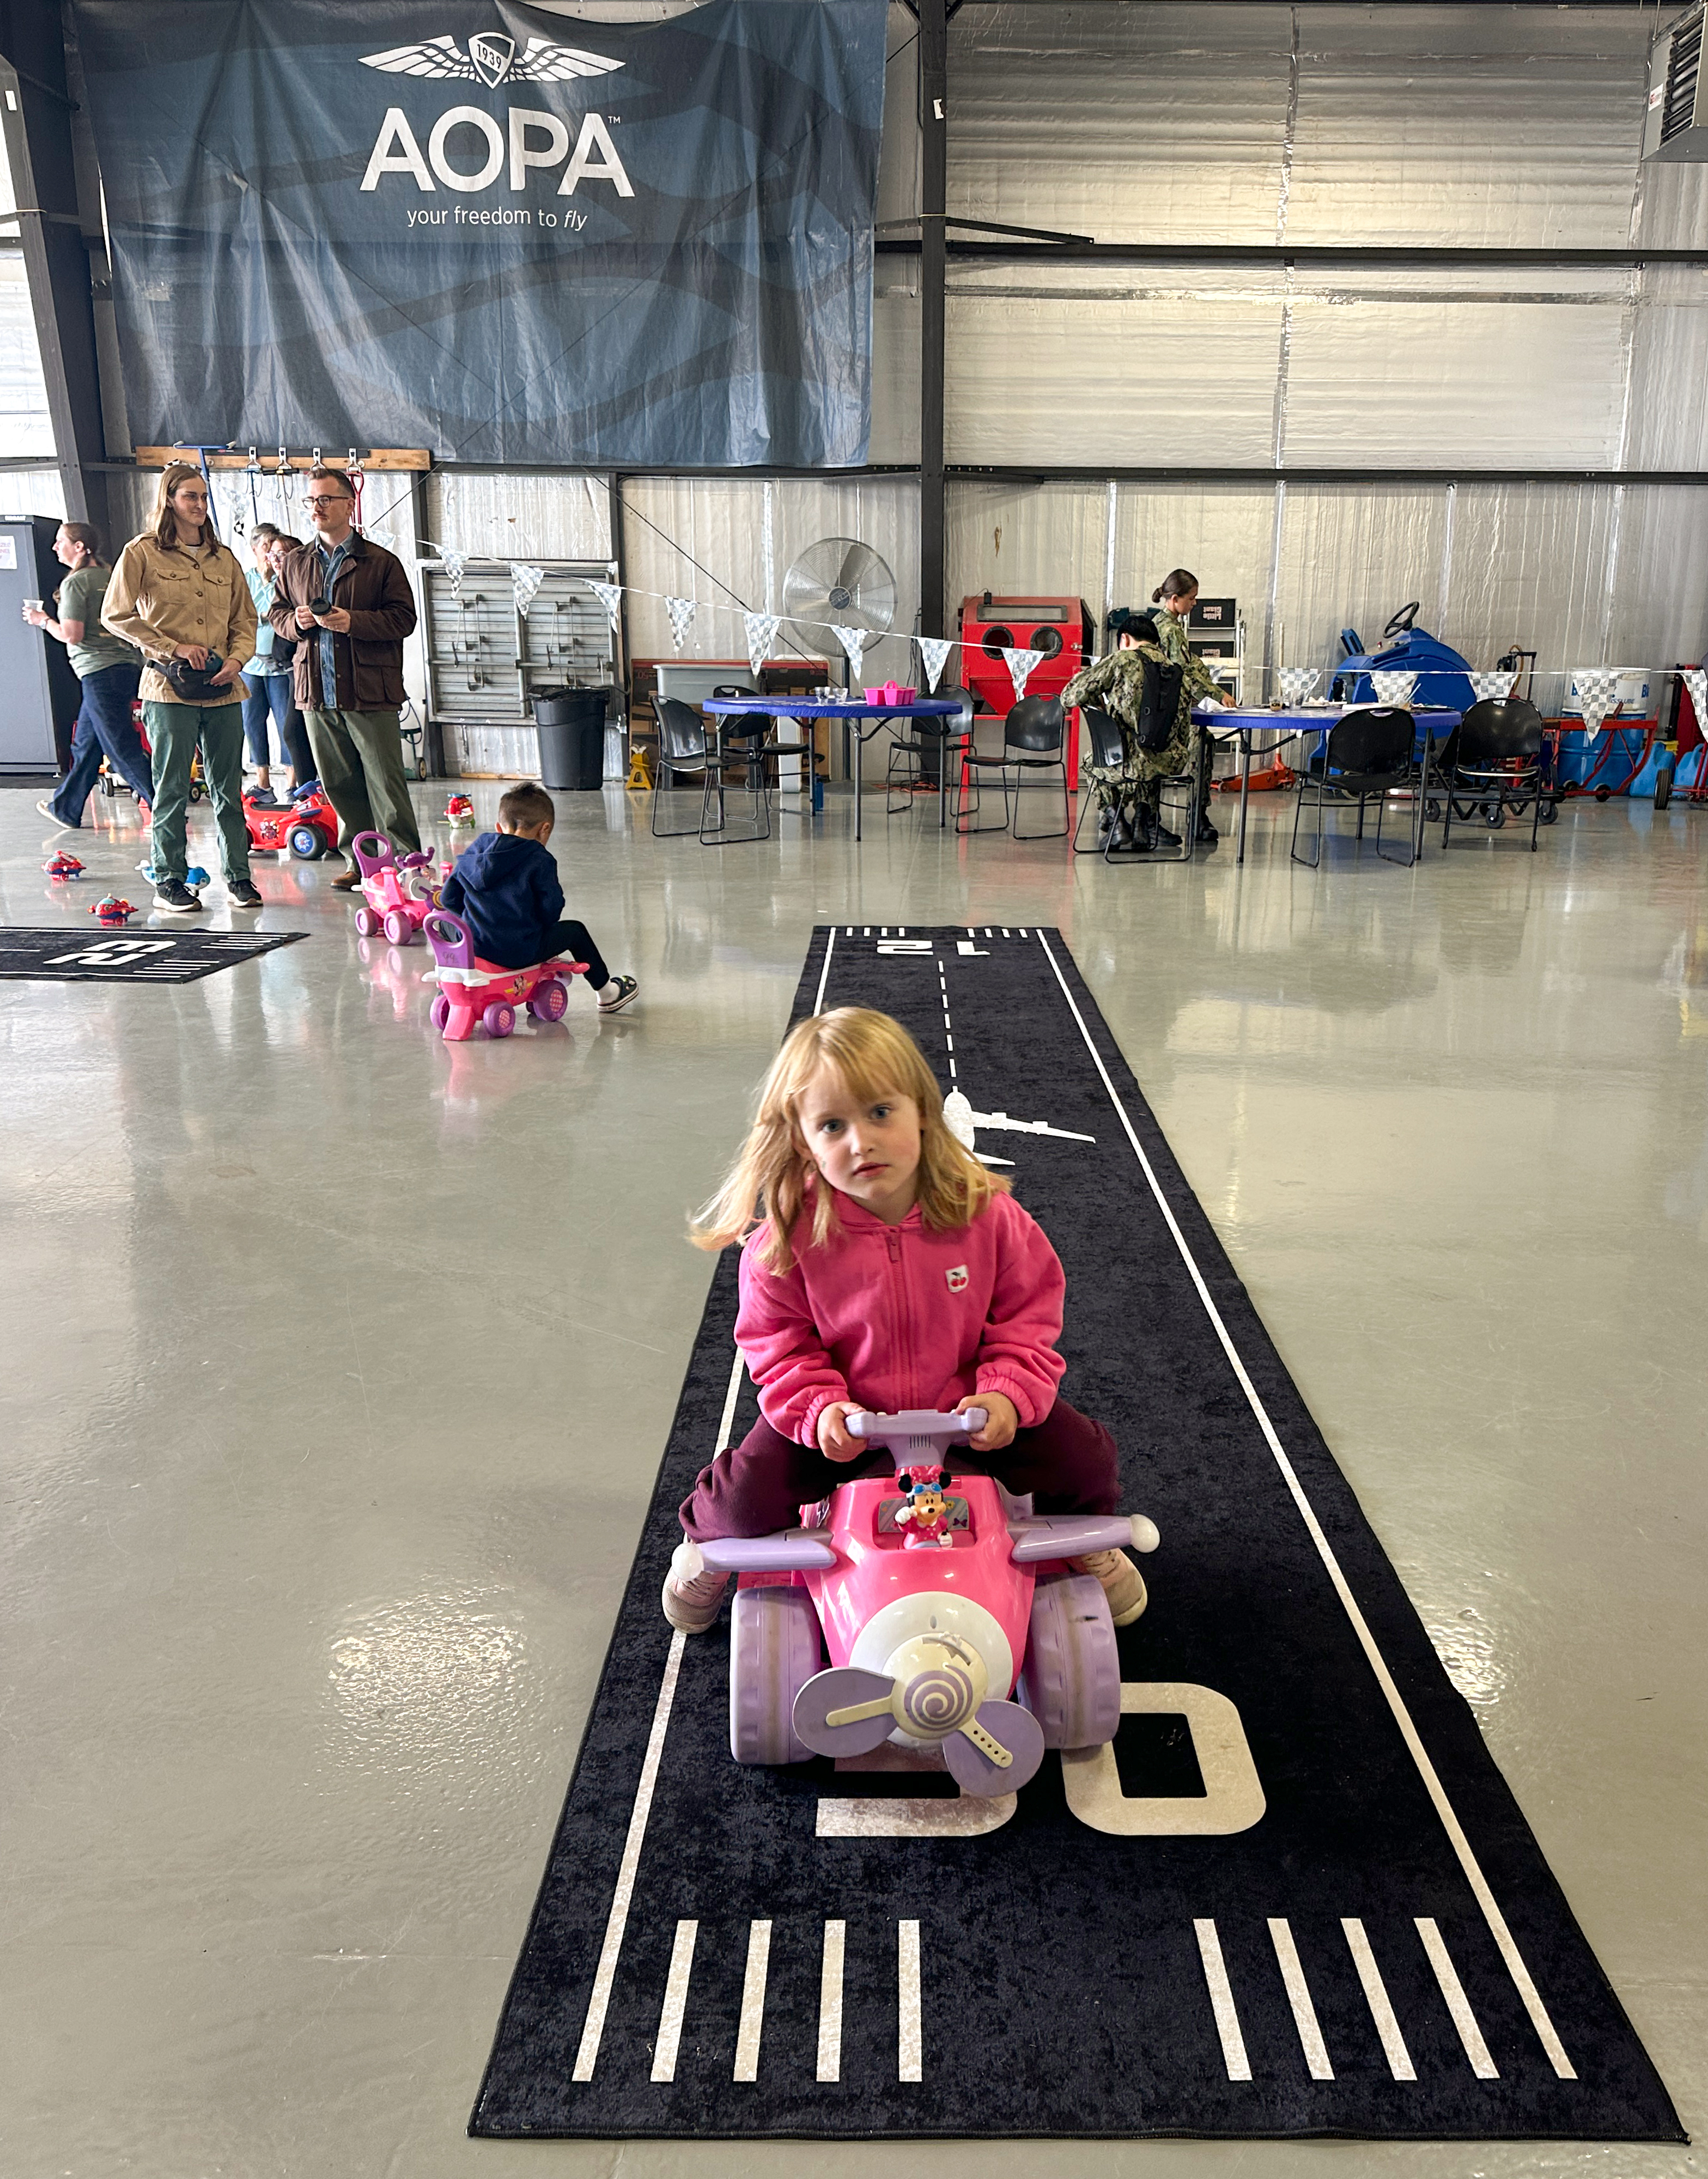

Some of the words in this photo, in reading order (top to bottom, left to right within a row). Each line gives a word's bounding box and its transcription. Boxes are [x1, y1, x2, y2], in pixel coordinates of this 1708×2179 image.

[476, 44, 503, 70] 1939
[359, 105, 635, 197] AOPA
[406, 206, 448, 227] your
[454, 205, 531, 225] freedom
[538, 209, 557, 227] to
[563, 210, 588, 231] fly
